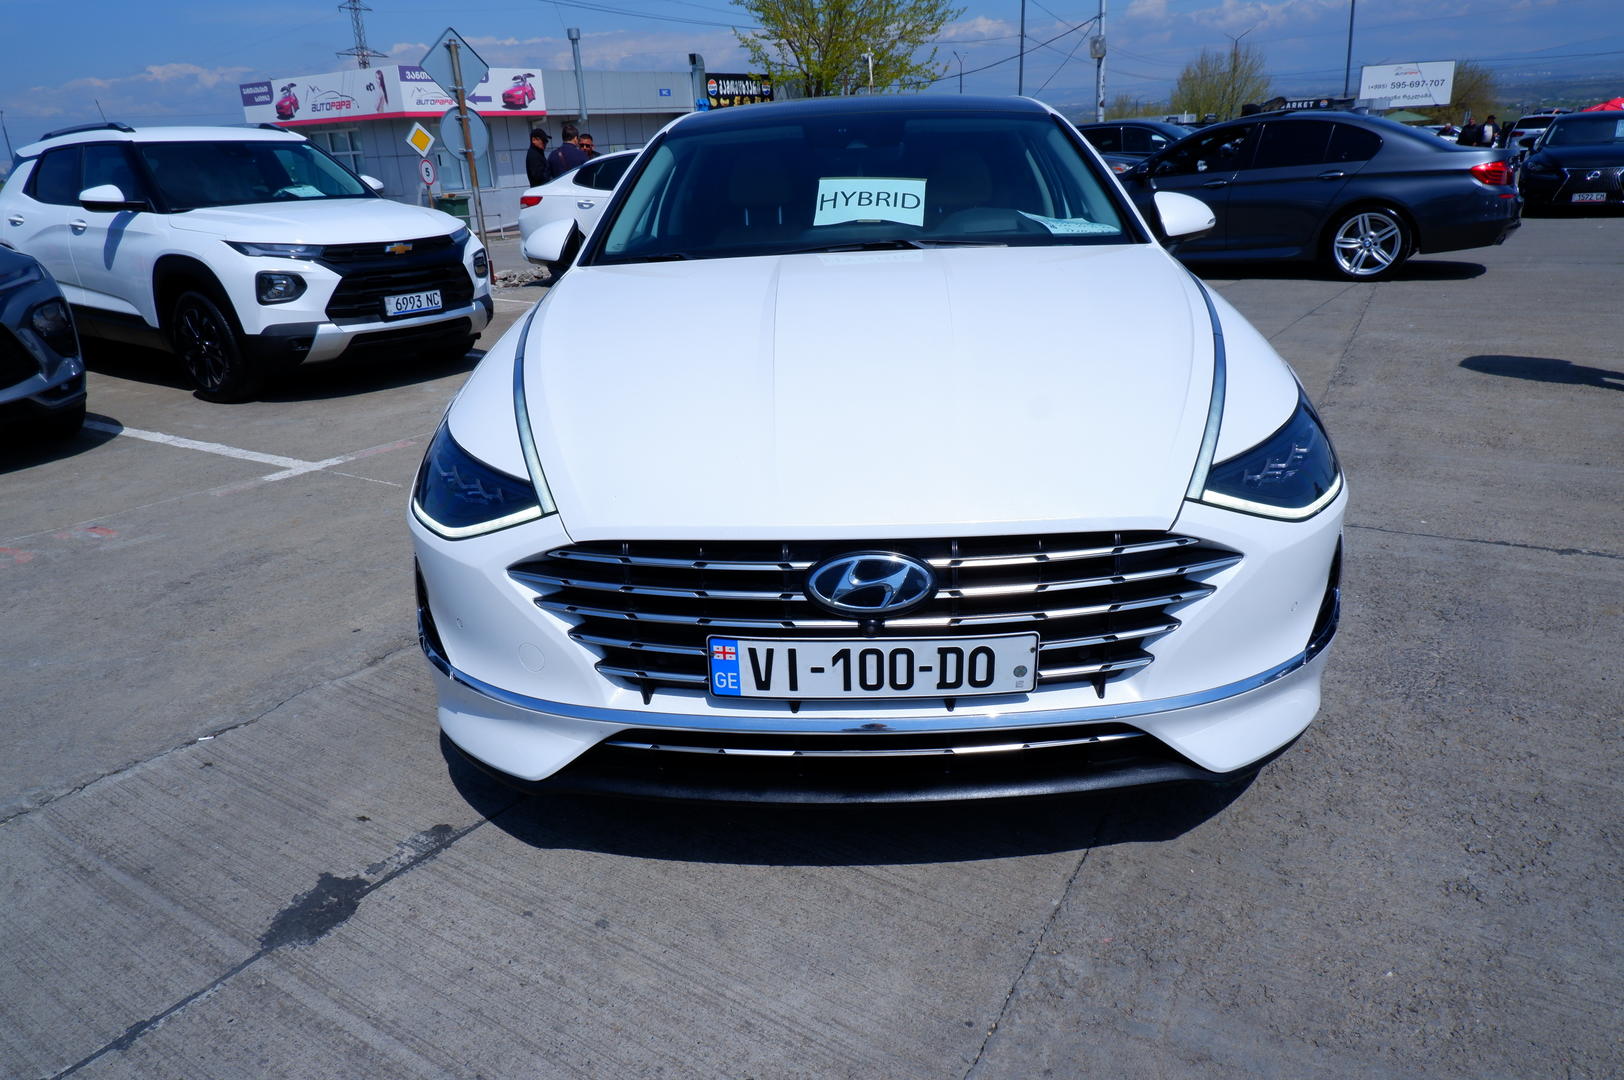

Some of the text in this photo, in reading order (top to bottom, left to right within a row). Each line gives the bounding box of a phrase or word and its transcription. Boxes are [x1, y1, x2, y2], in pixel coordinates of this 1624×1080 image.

[1390, 79, 1446, 90] 595-697-707
[425, 167, 431, 177] 5
[819, 191, 921, 212] HYBRID
[395, 292, 440, 311] 6993 NC
[714, 671, 738, 690] GE
